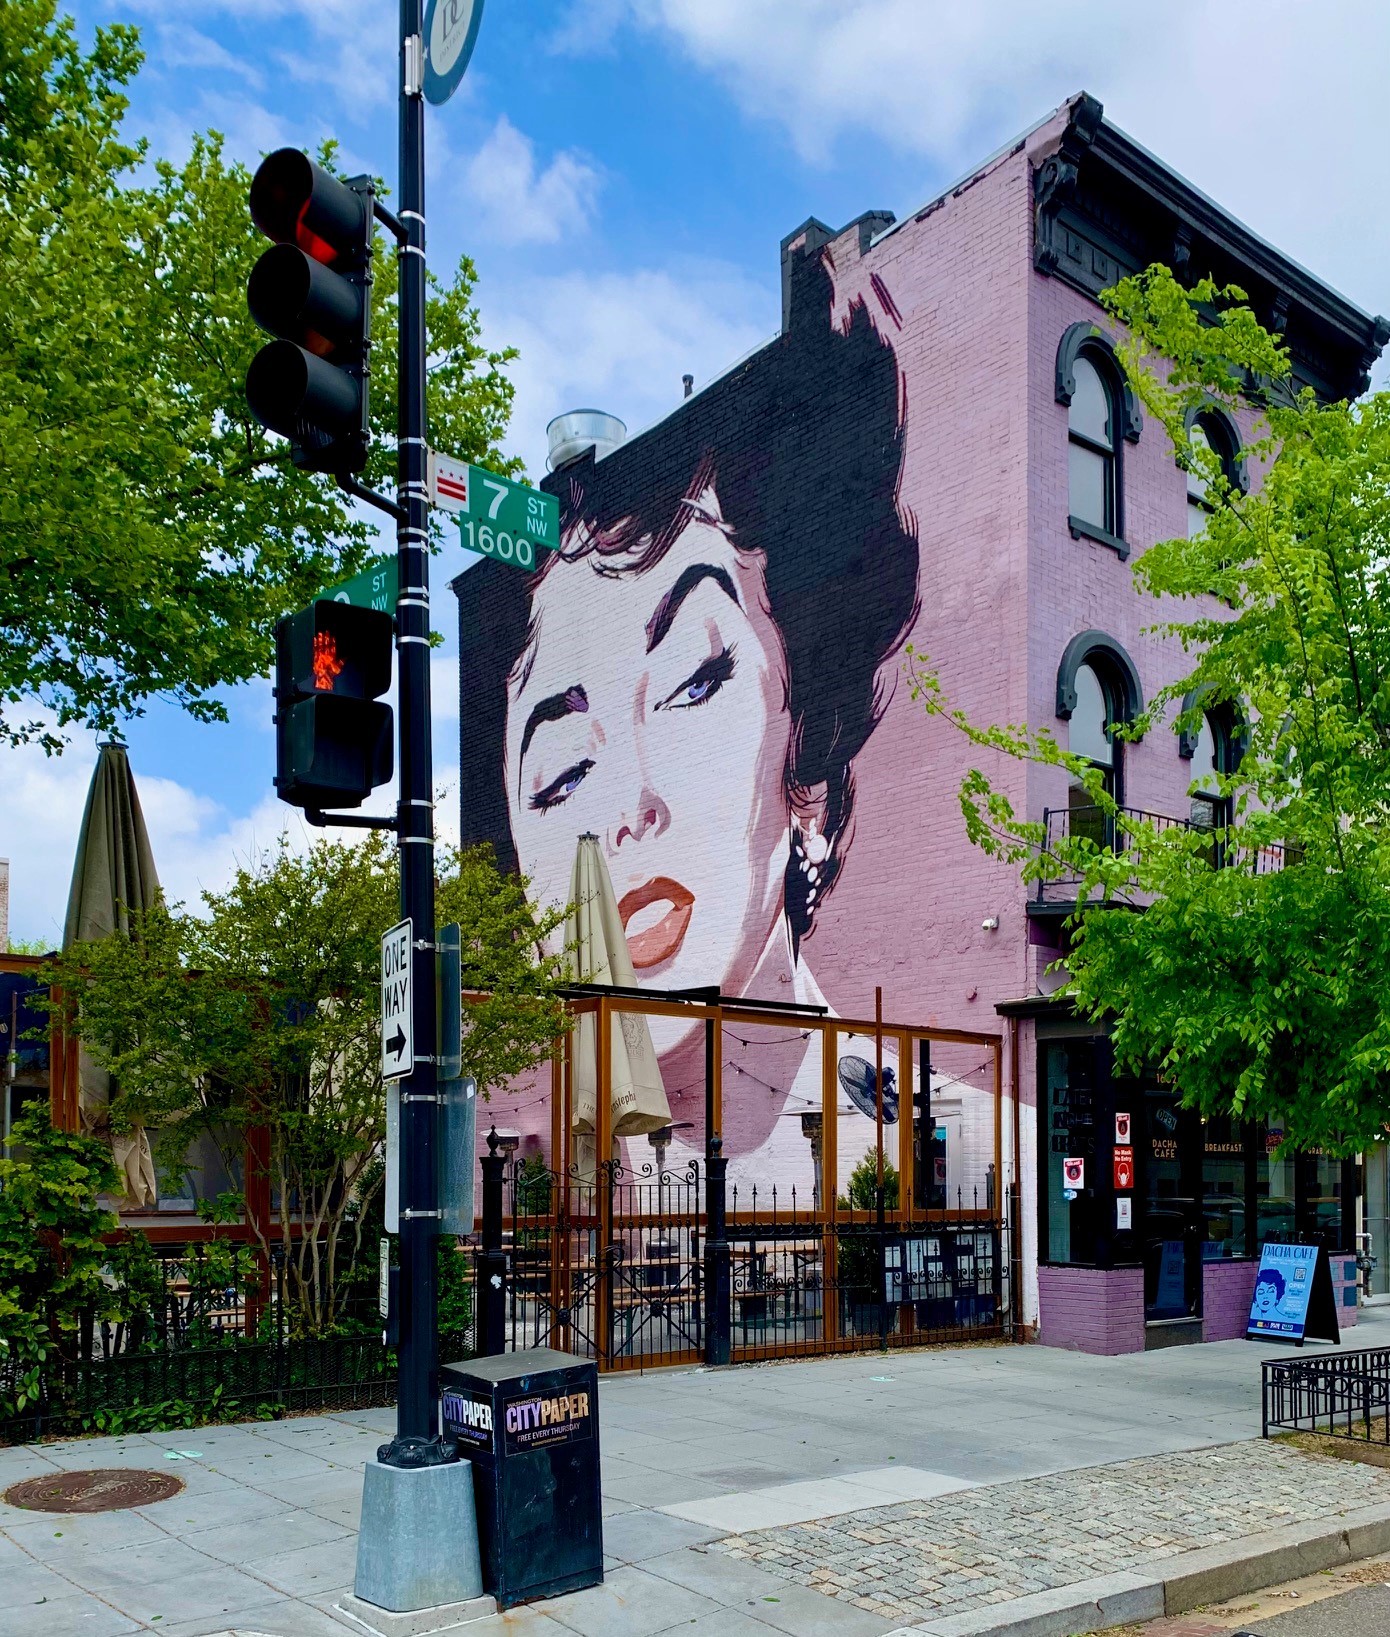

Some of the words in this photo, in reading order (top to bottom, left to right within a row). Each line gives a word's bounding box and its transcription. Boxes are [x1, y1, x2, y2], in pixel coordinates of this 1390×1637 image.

[483, 479, 509, 520] 7
[527, 497, 547, 517] ST
[526, 516, 548, 537] NW
[464, 521, 533, 566] 1600
[372, 572, 387, 592] ST
[371, 593, 388, 611] NW
[384, 935, 407, 978] ONE
[384, 977, 408, 1020] WAY
[1158, 1109, 1177, 1129] OPEN
[1152, 1138, 1178, 1149] DACHA
[1204, 1143, 1242, 1153] BREAKFAST
[1265, 1134, 1284, 1146] OPEN
[1154, 1148, 1175, 1158] CAFE
[1264, 1245, 1291, 1258] DACHA
[506, 1396, 542, 1408] WASHINGTON
[517, 1432, 532, 1443] FREE
[532, 1428, 551, 1440] EVERY
[550, 1421, 581, 1436] THURSDAY
